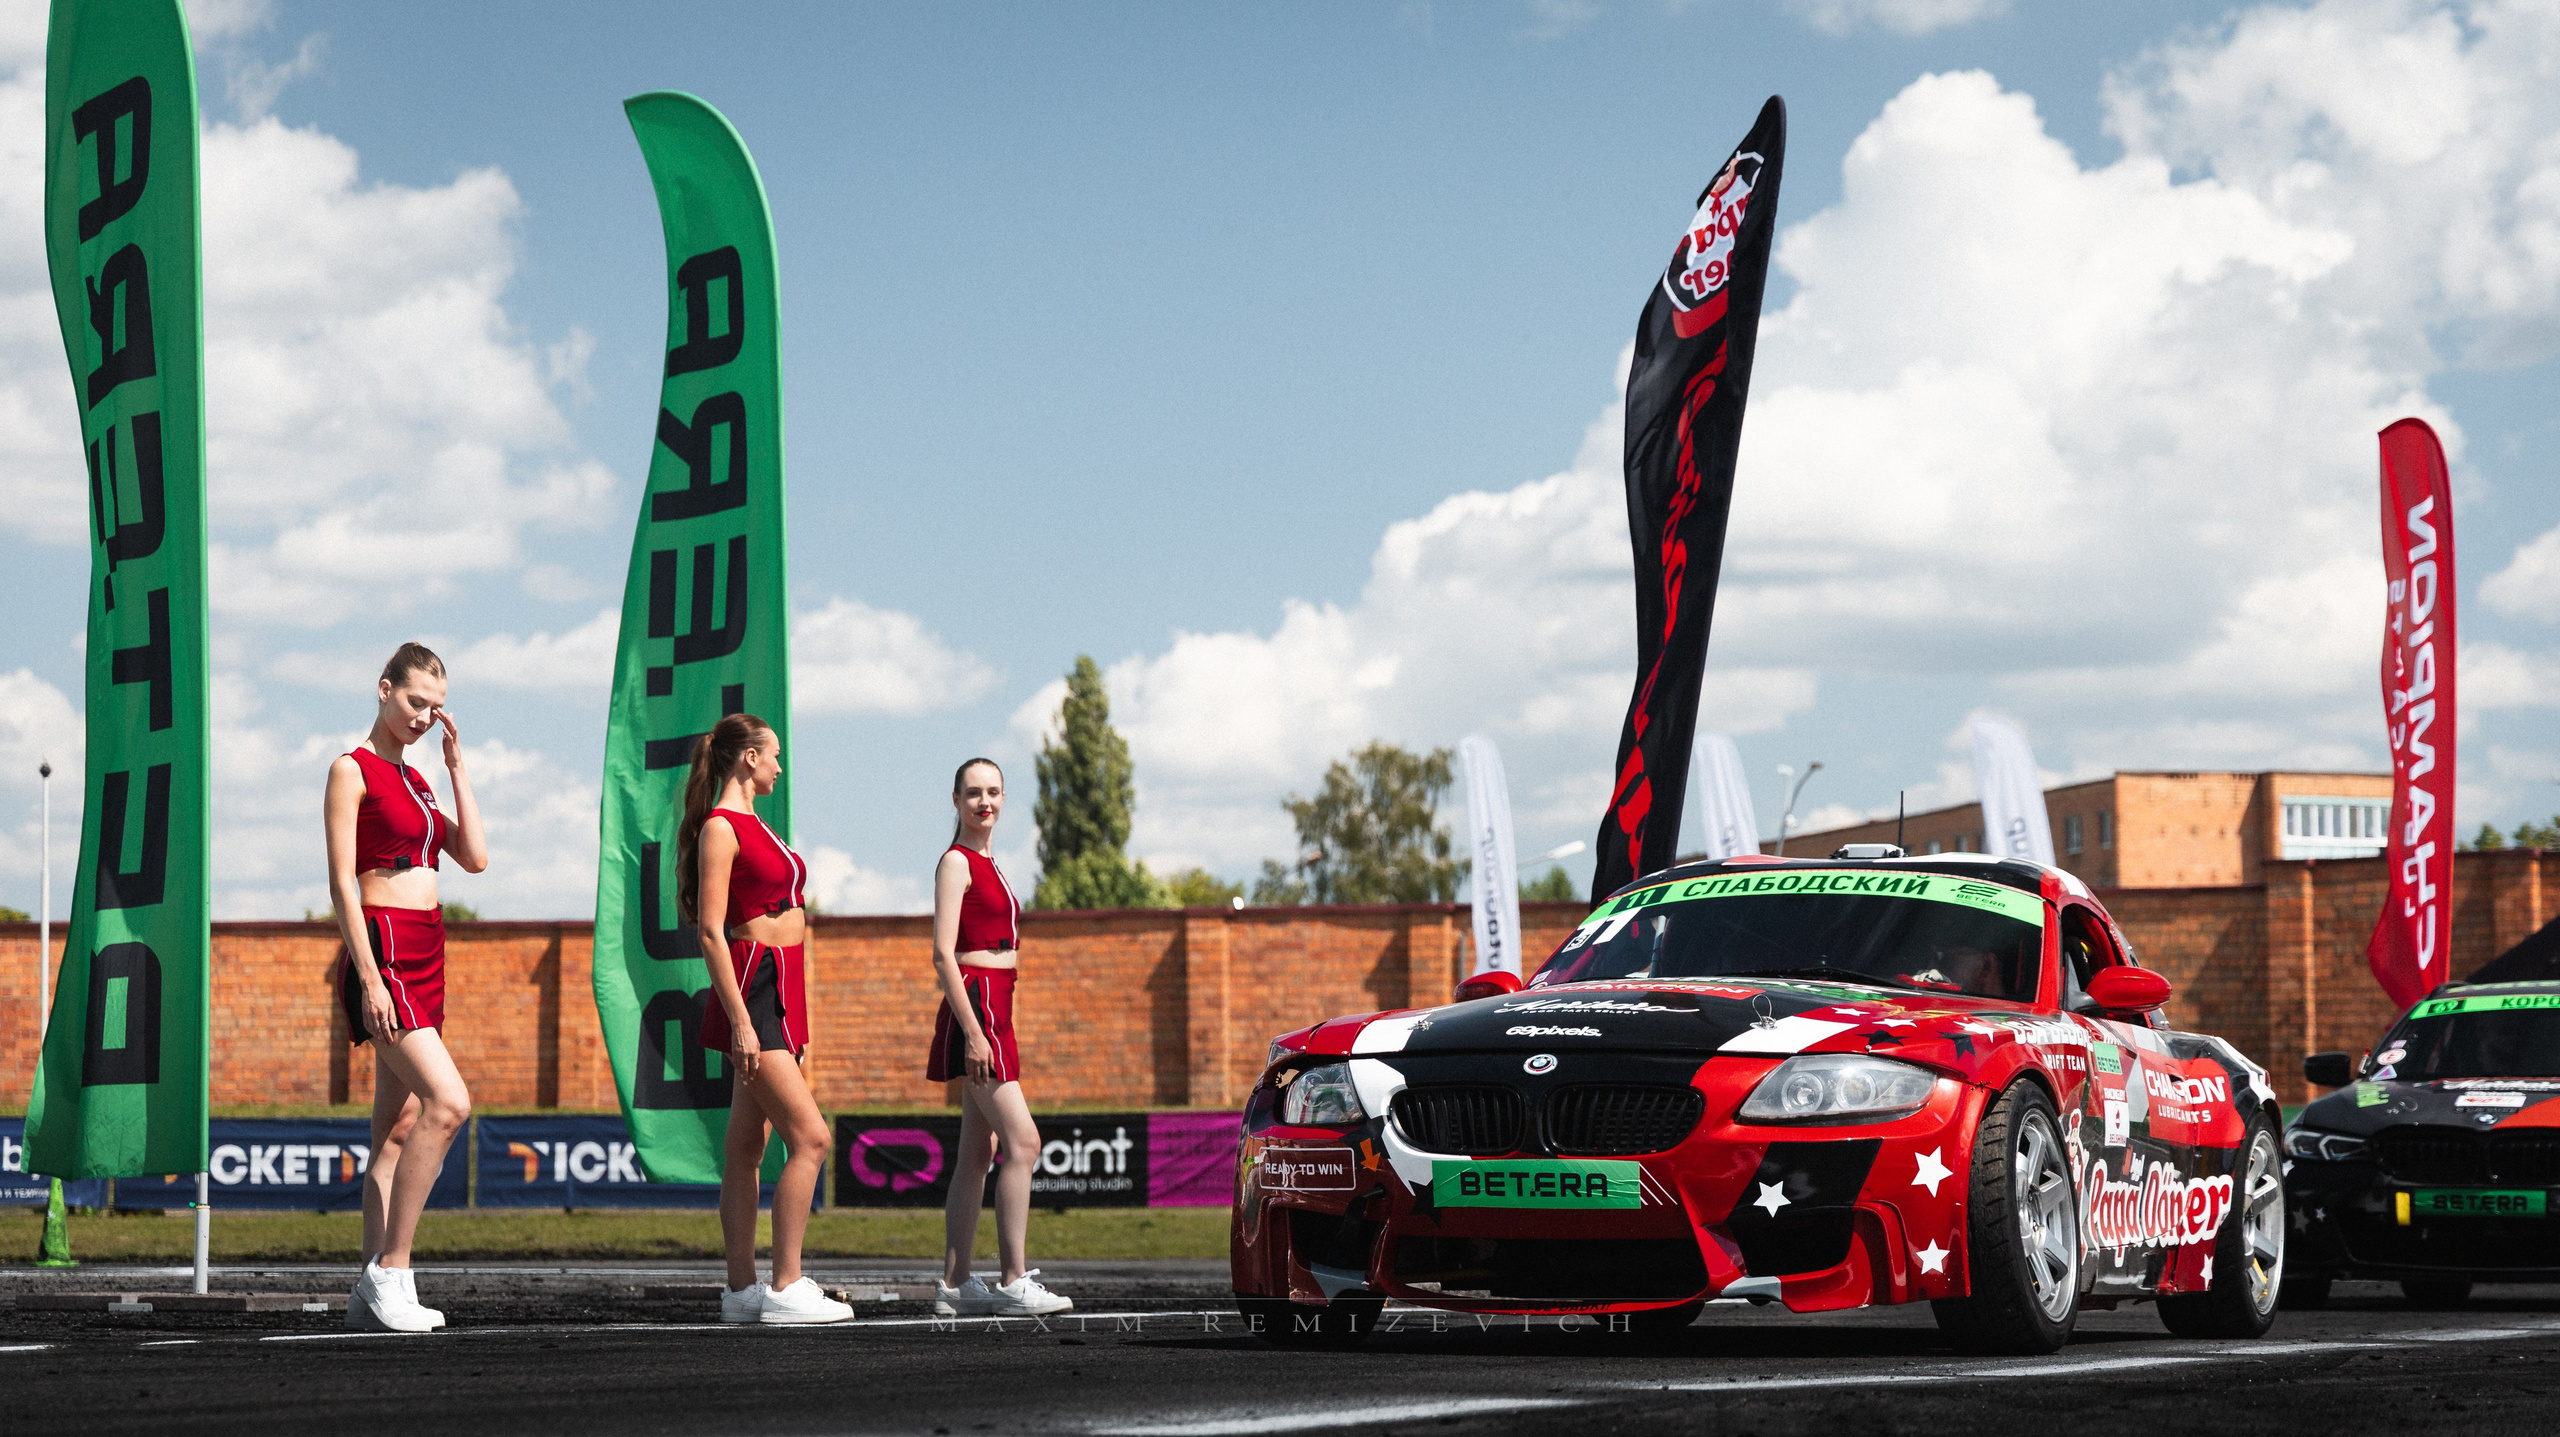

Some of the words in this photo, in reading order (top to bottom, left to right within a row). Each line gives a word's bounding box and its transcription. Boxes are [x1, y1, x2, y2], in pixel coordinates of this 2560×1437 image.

[1625, 889, 1657, 909] 11
[1682, 875, 1931, 897] СЛАБОДСКИЙ
[2043, 1054, 2065, 1070] DRIFT
[2066, 1055, 2086, 1072] TEAM
[1265, 1163, 1297, 1175] READY
[1300, 1163, 1315, 1175] TO
[1318, 1163, 1343, 1175] WIN
[1090, 1176, 1133, 1190] studio
[2090, 1160, 2143, 1267] Papa
